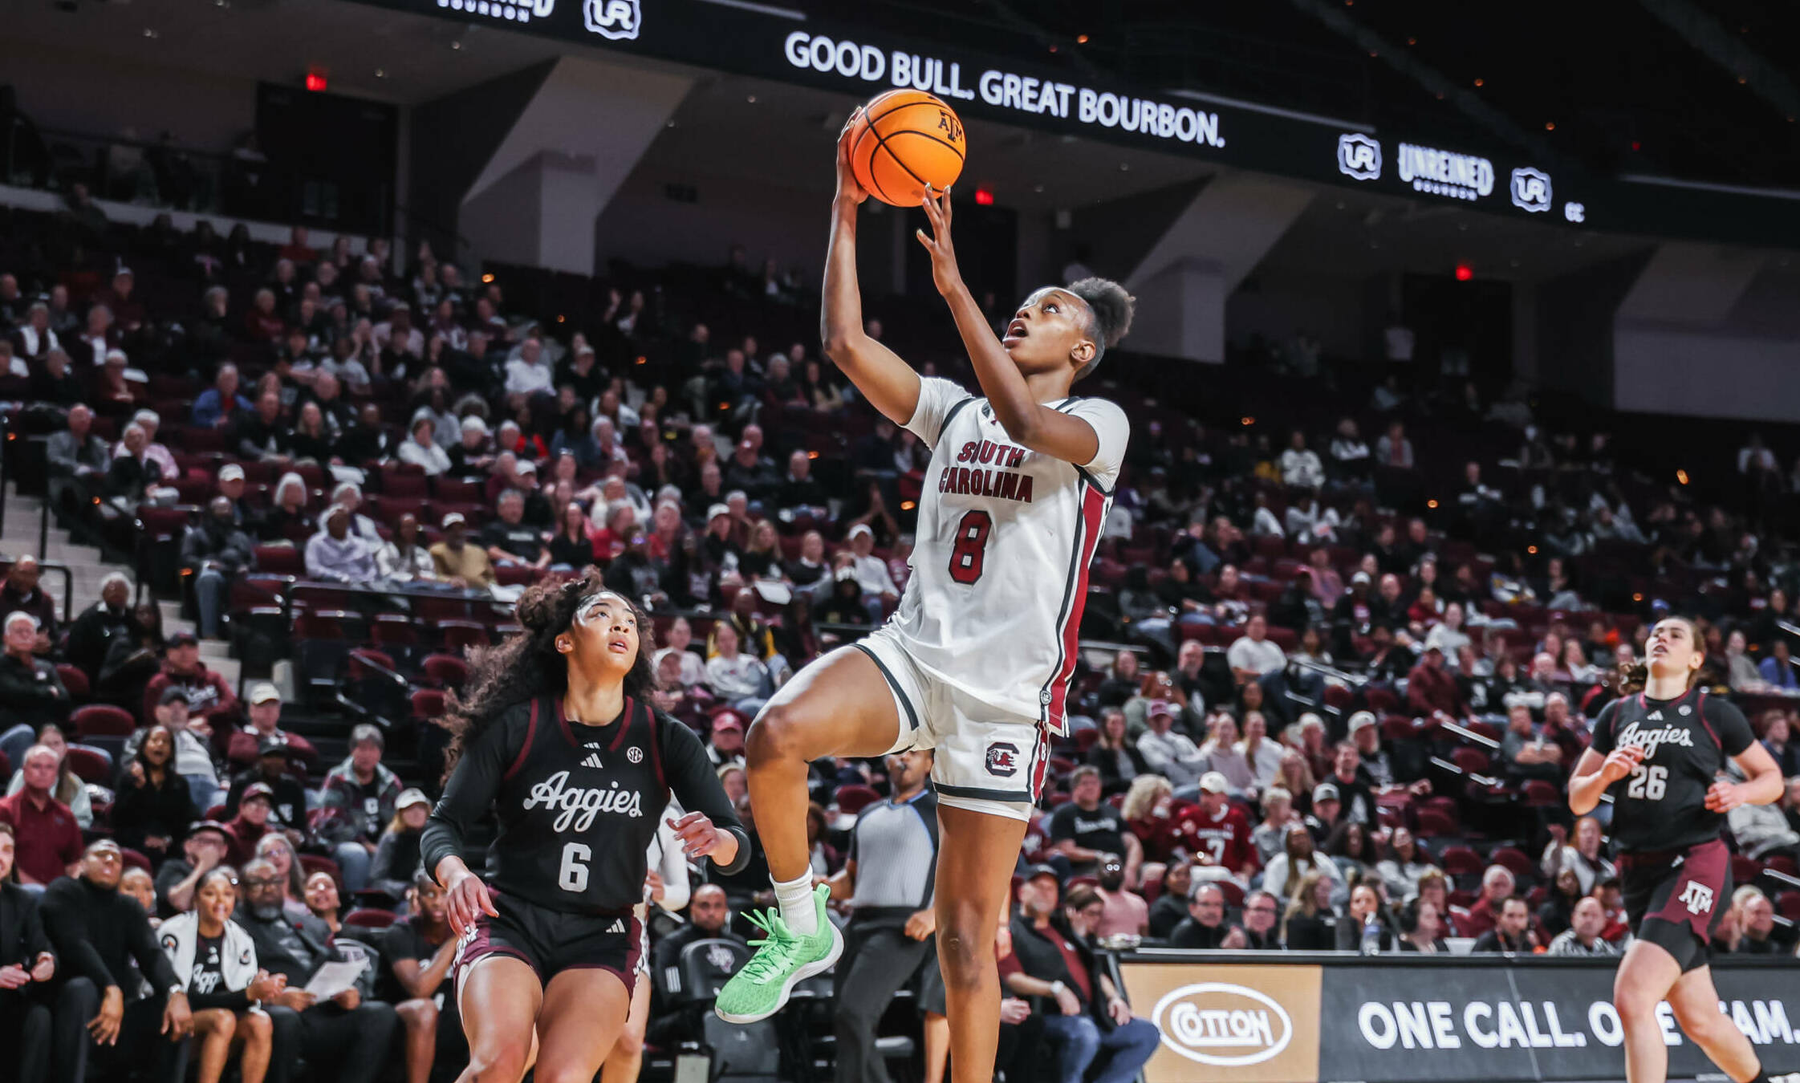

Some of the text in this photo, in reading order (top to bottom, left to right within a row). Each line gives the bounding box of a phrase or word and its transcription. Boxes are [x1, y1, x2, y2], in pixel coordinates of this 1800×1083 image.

[785, 31, 1226, 148] GOOD BULL. GREAT BOURBON.
[957, 440, 1025, 468] SOUTH
[938, 467, 1034, 503] CAROLINA
[949, 509, 992, 585] 8
[1616, 721, 1694, 760] Aggies
[523, 771, 643, 832] Aggies
[1628, 765, 1668, 800] 26
[558, 842, 592, 893] 6
[193, 963, 220, 994] Agg
[1170, 1002, 1274, 1046] COTTON
[1358, 1000, 1800, 1049] ONE CALL. OE AM.
